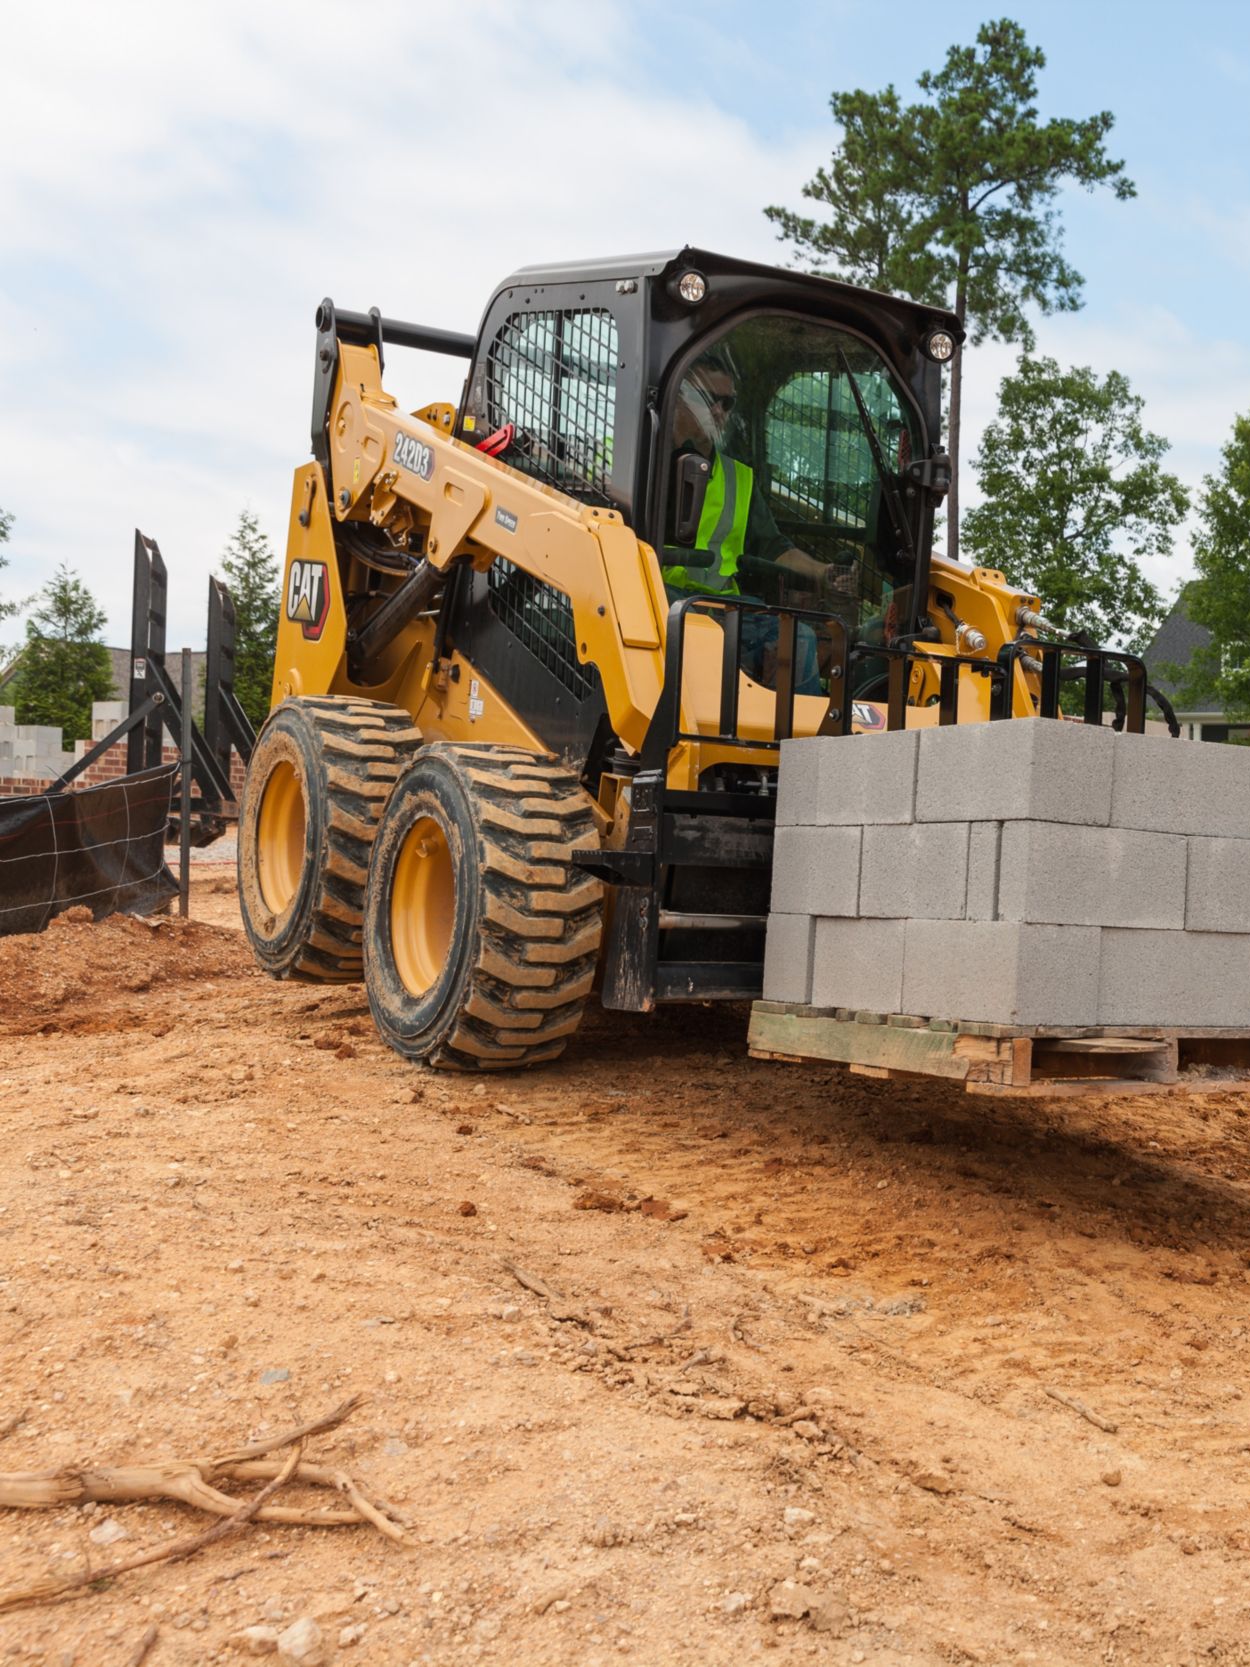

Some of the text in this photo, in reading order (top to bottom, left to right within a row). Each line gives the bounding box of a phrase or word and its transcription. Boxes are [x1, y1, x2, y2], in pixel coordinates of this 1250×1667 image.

[393, 432, 430, 478] 242D3
[286, 560, 324, 622] CAT
[851, 703, 873, 724] AT
